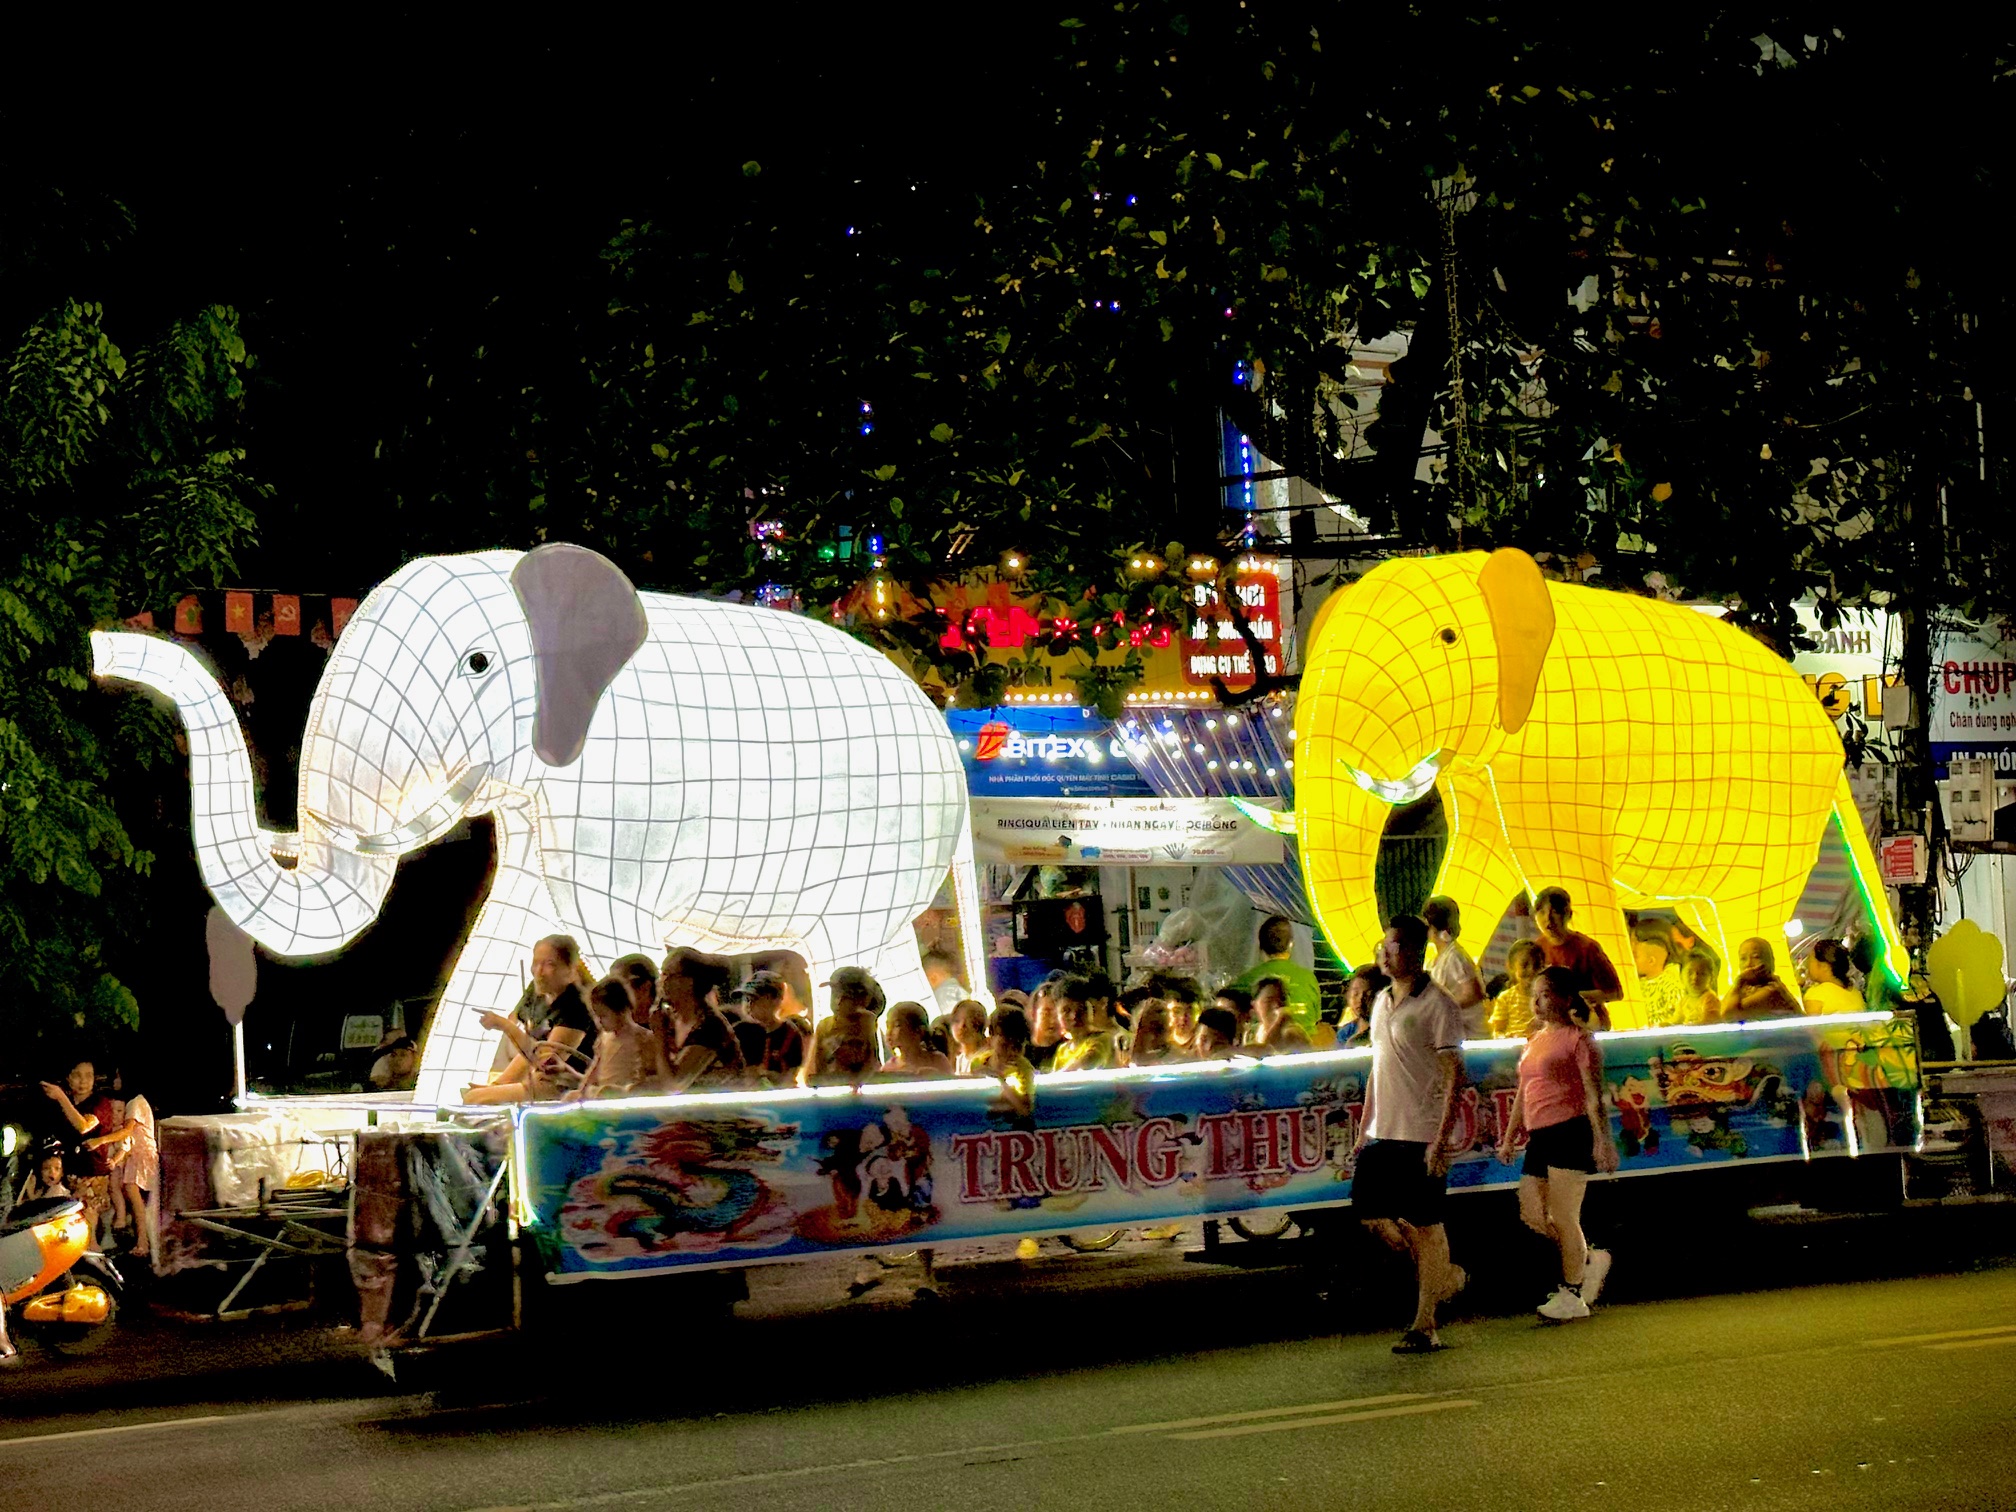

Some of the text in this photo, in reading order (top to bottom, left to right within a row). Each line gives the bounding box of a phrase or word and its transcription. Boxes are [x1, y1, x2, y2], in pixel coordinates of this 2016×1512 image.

[1006, 737, 1085, 758] BITEX
[951, 1116, 1183, 1203] TRUNG
[1196, 1105, 1328, 1179] THU
